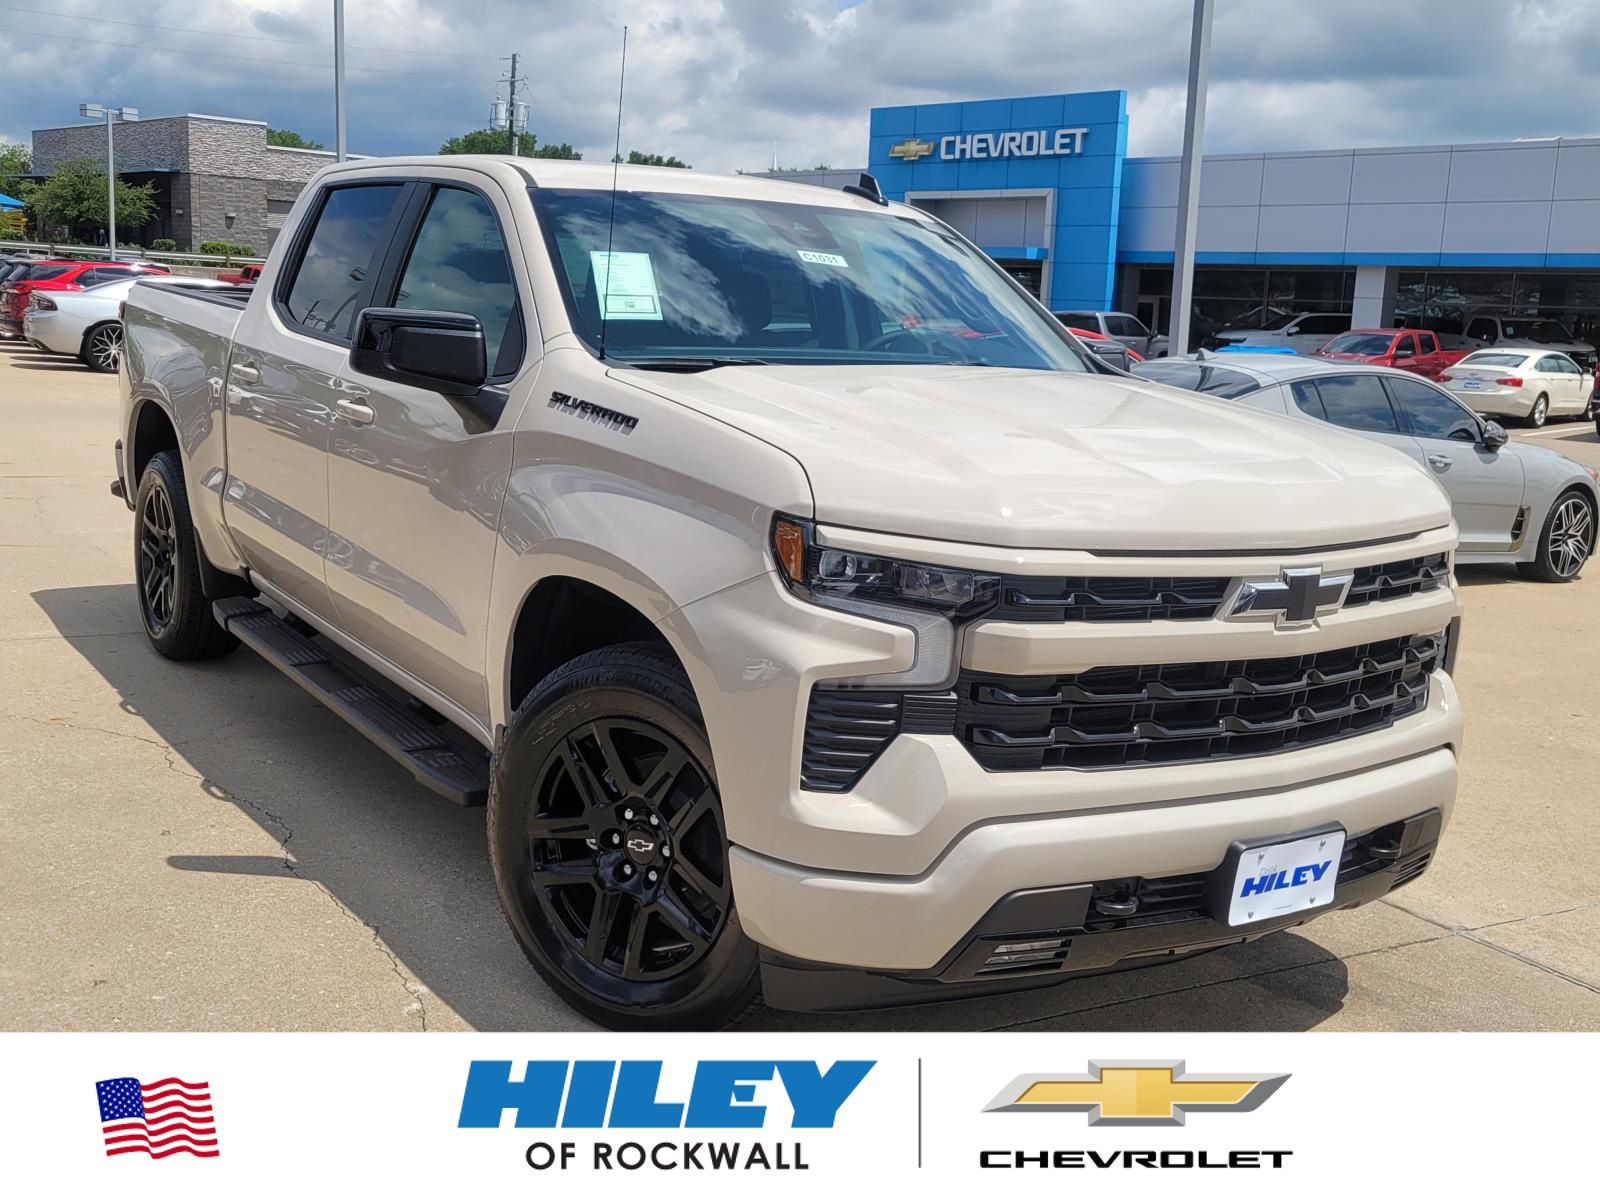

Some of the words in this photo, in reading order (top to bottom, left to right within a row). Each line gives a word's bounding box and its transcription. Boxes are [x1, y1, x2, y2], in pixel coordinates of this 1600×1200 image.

[940, 128, 1089, 160] CHEVROLET
[549, 391, 639, 431] SILVERADO
[1240, 860, 1332, 898] HILEY
